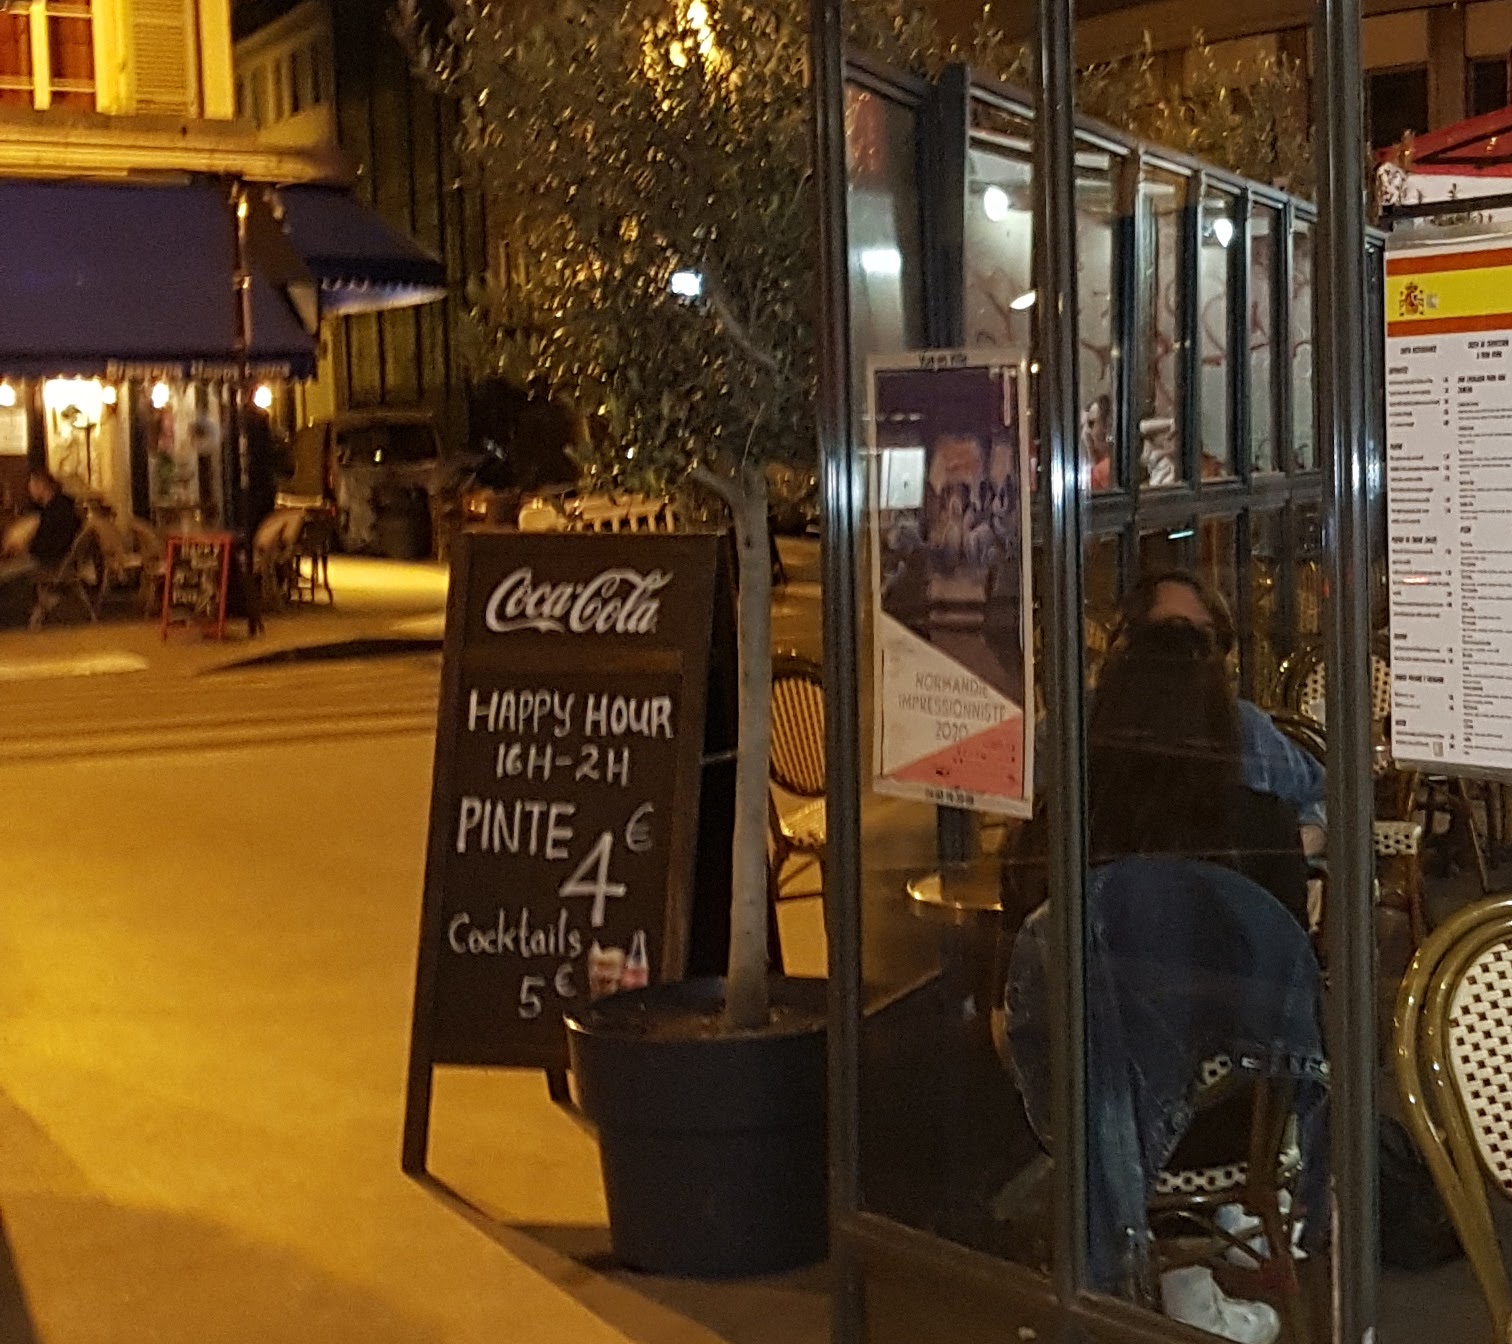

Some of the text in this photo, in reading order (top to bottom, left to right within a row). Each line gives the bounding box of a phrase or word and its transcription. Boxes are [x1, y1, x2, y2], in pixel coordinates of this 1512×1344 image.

[485, 567, 674, 635] Coca-Cola
[468, 688, 675, 739] HAPPY HOUR
[456, 796, 576, 861] PINTE
[448, 907, 583, 957] Cocktails
